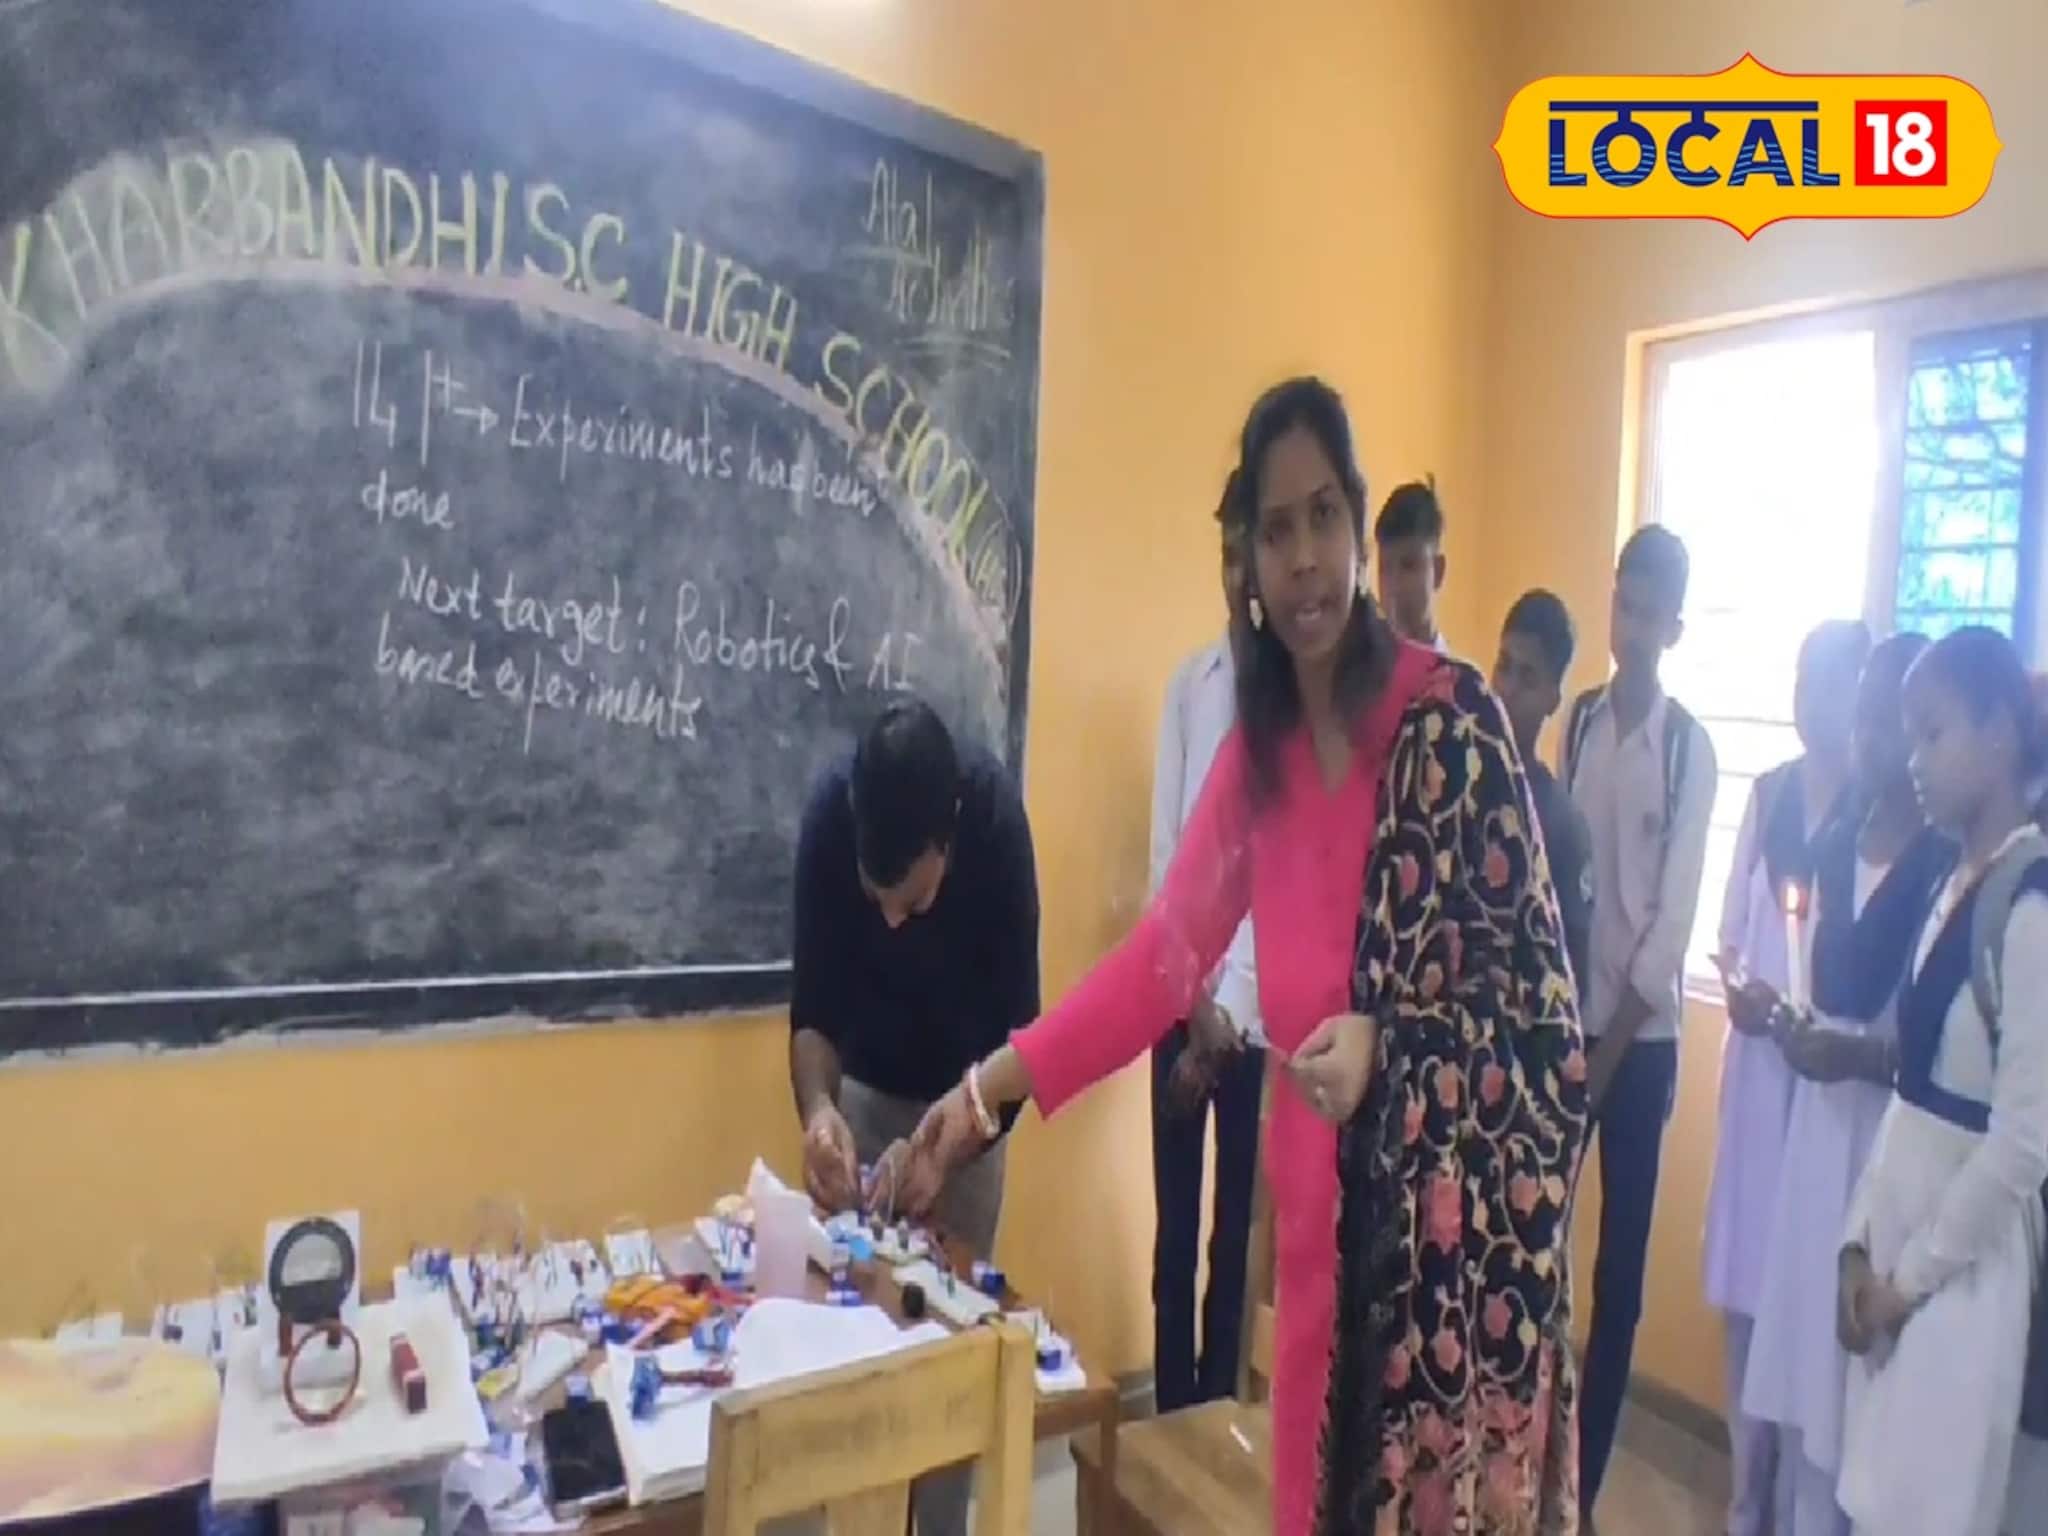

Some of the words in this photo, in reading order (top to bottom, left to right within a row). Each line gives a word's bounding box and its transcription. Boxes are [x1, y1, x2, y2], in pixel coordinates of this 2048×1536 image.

[510, 373, 733, 483] Experiments
[747, 422, 805, 494] has
[663, 231, 798, 374] HIGH
[815, 335, 989, 564] SCHOOL
[361, 468, 454, 530] done
[374, 610, 484, 698] based
[494, 648, 701, 755] experiments
[399, 558, 482, 620] Next
[675, 579, 820, 691] Robotics
[866, 632, 922, 691] AI
